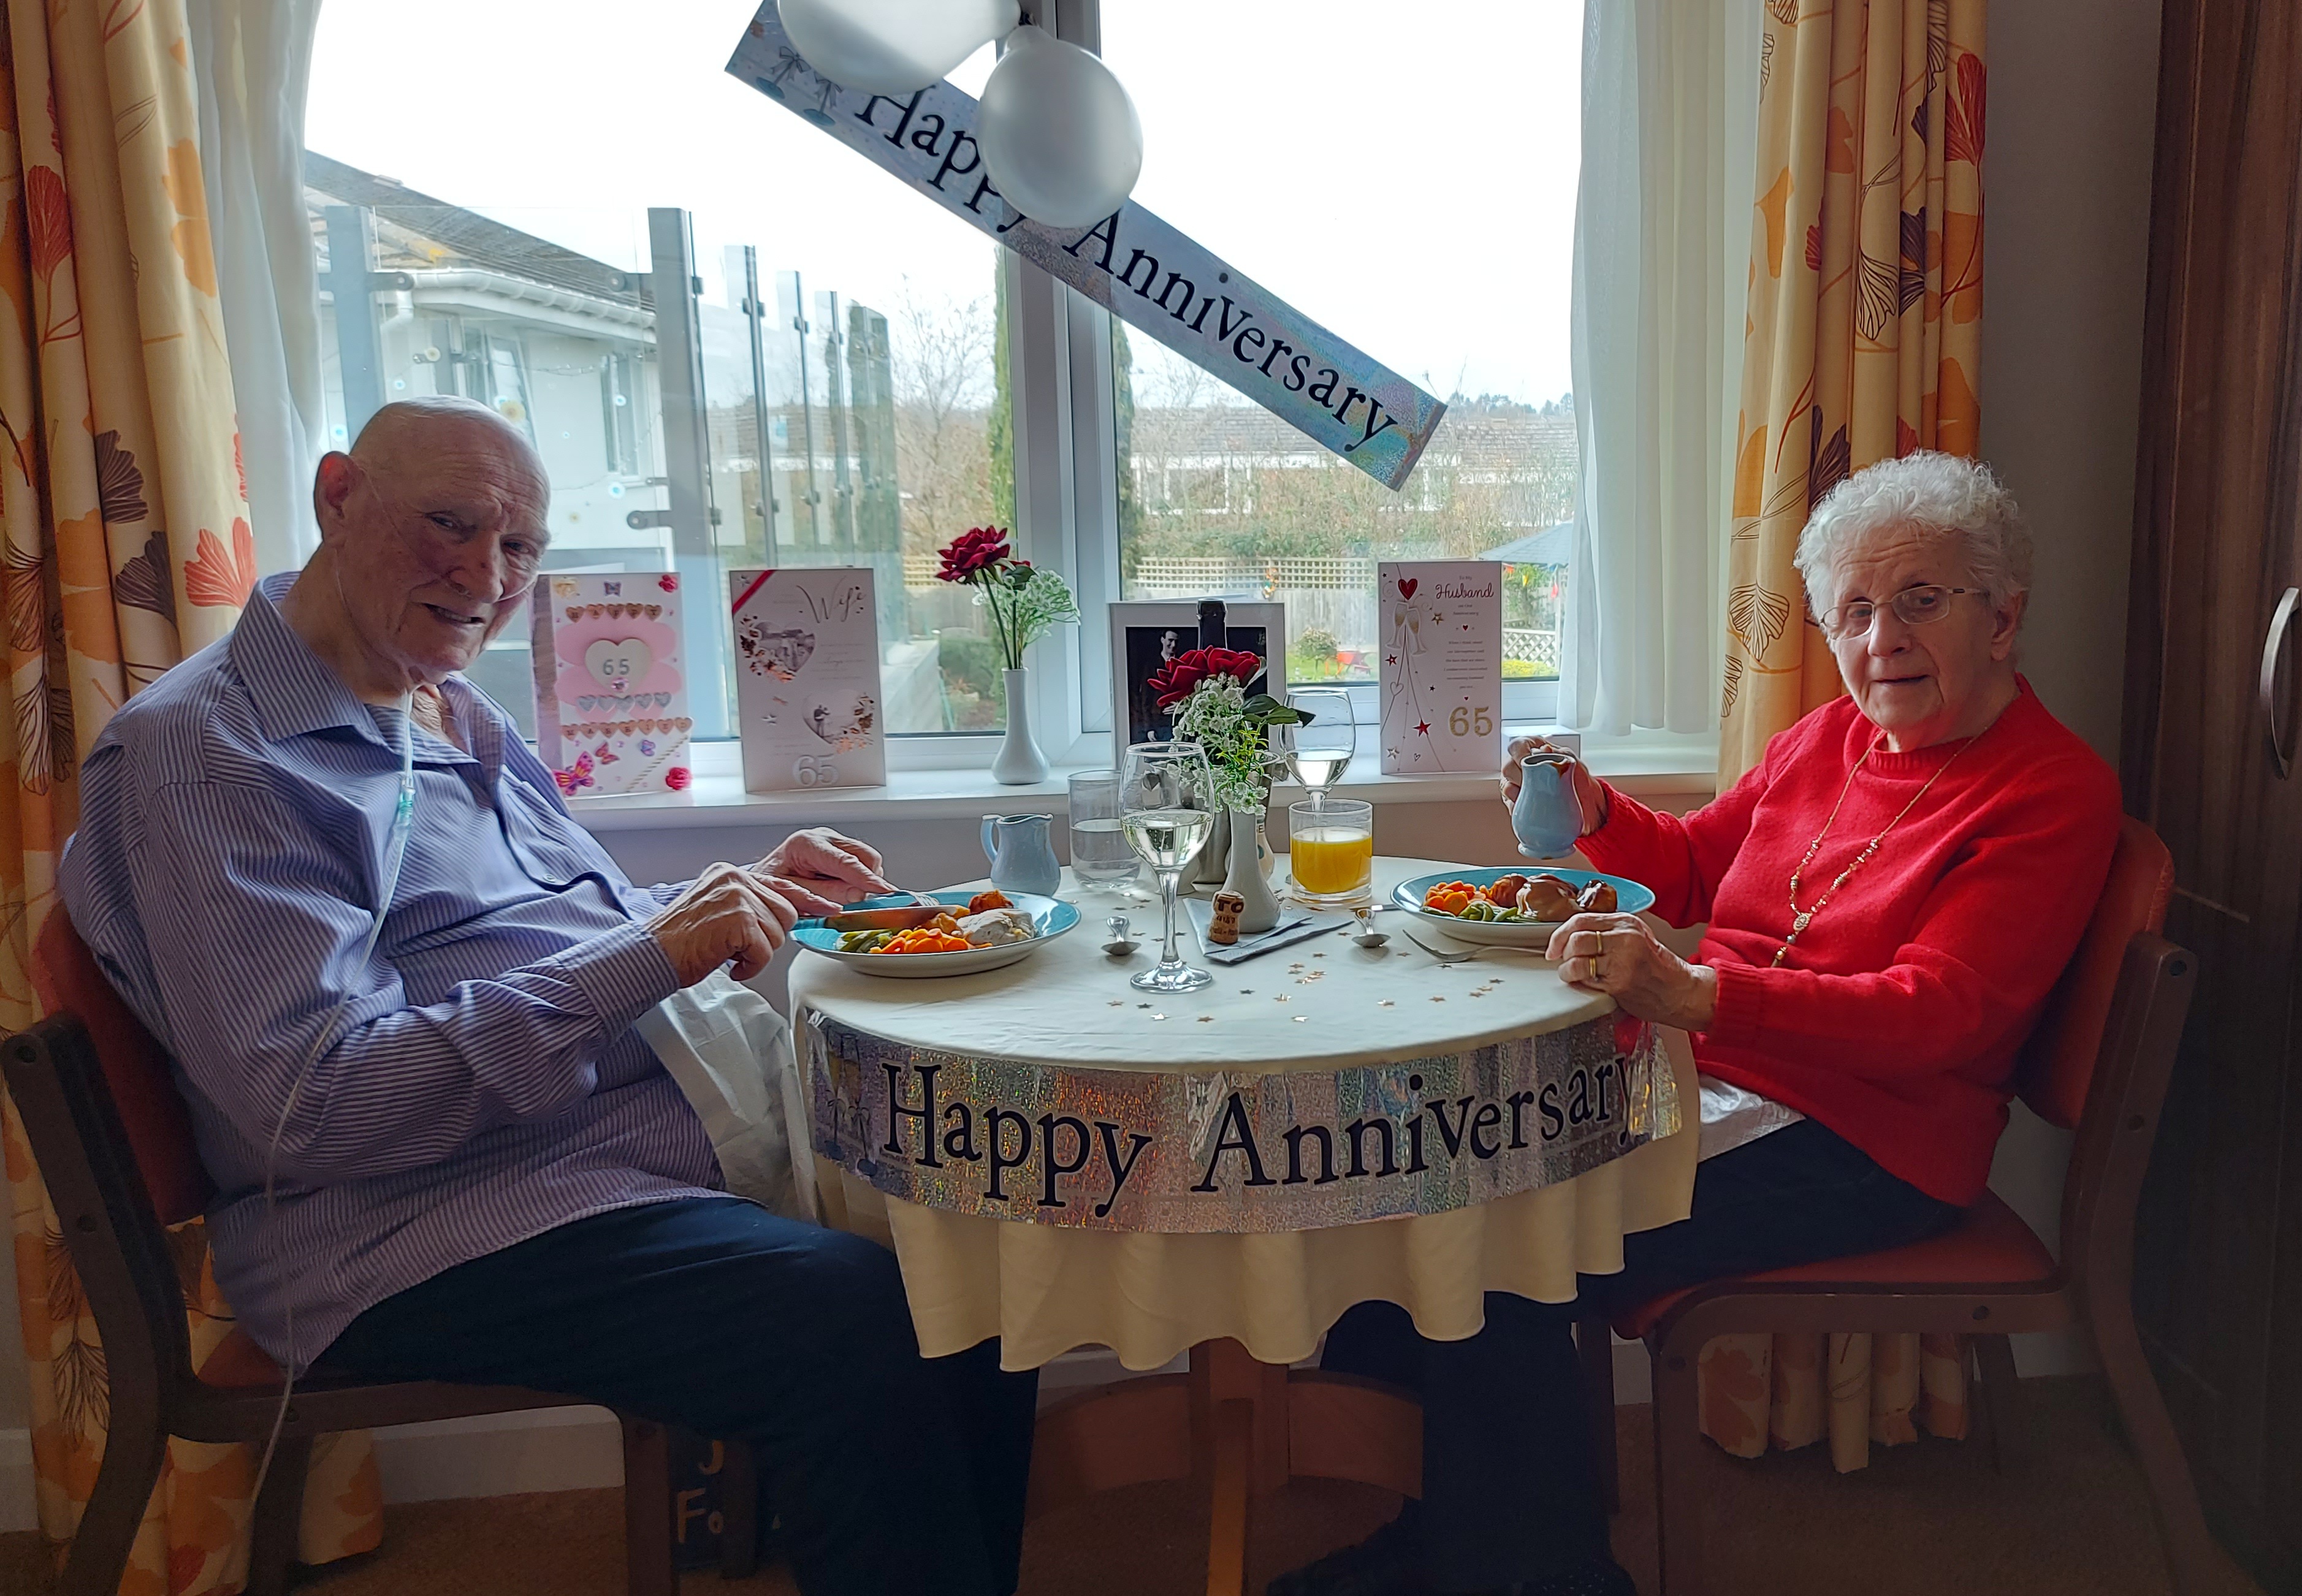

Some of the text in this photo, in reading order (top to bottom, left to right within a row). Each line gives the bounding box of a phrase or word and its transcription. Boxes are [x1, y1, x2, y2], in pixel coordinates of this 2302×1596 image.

[1061, 208, 1398, 452] Anniversary
[1435, 582, 1495, 599] Husband
[602, 658, 631, 676] 65
[1448, 706, 1493, 738] 65
[791, 754, 839, 787] 65
[881, 1056, 1631, 1218] Happy Anniversary
